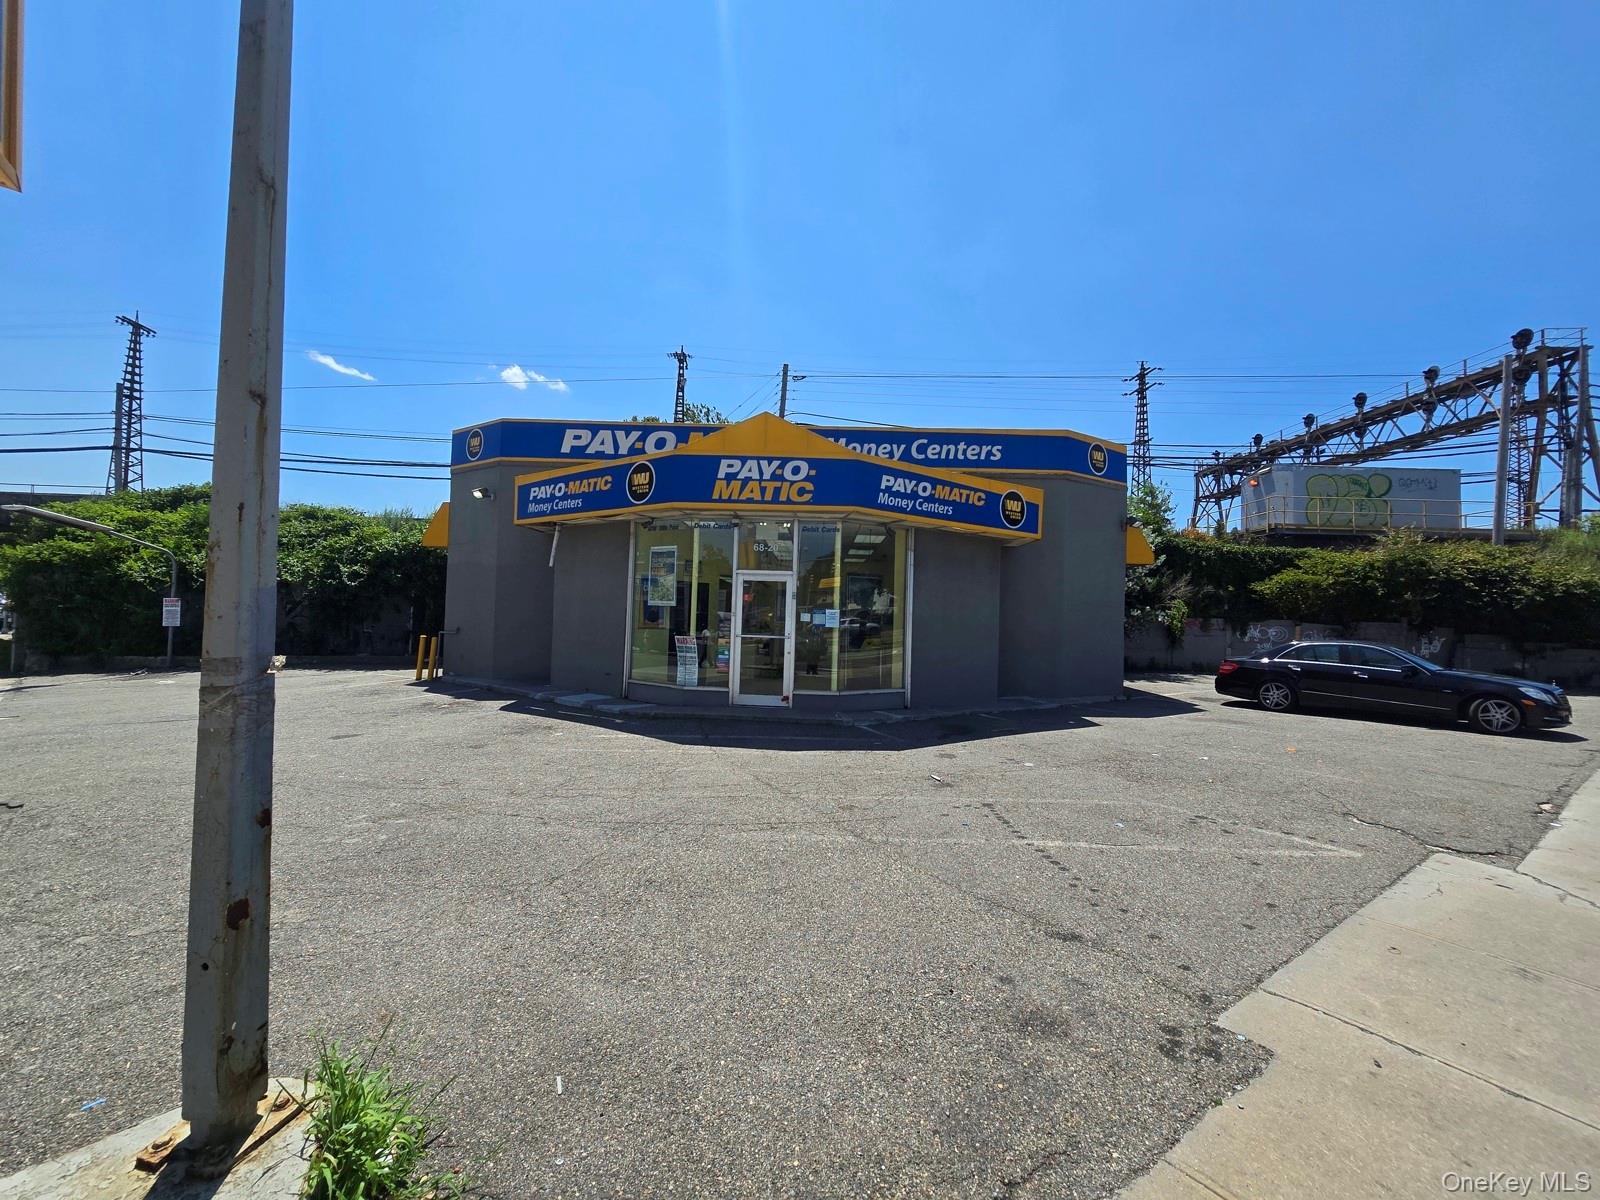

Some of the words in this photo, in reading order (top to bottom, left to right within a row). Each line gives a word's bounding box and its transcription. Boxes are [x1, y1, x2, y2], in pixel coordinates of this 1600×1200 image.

[911, 438, 1003, 461] Centers
[529, 475, 613, 501] PAY-O-MATIC
[711, 480, 815, 503] MATIC
[880, 474, 987, 506] PAY-O-MATIC
[527, 500, 552, 514] Money
[553, 498, 583, 511] Centers
[877, 492, 915, 511] Money
[915, 498, 953, 515] Centers
